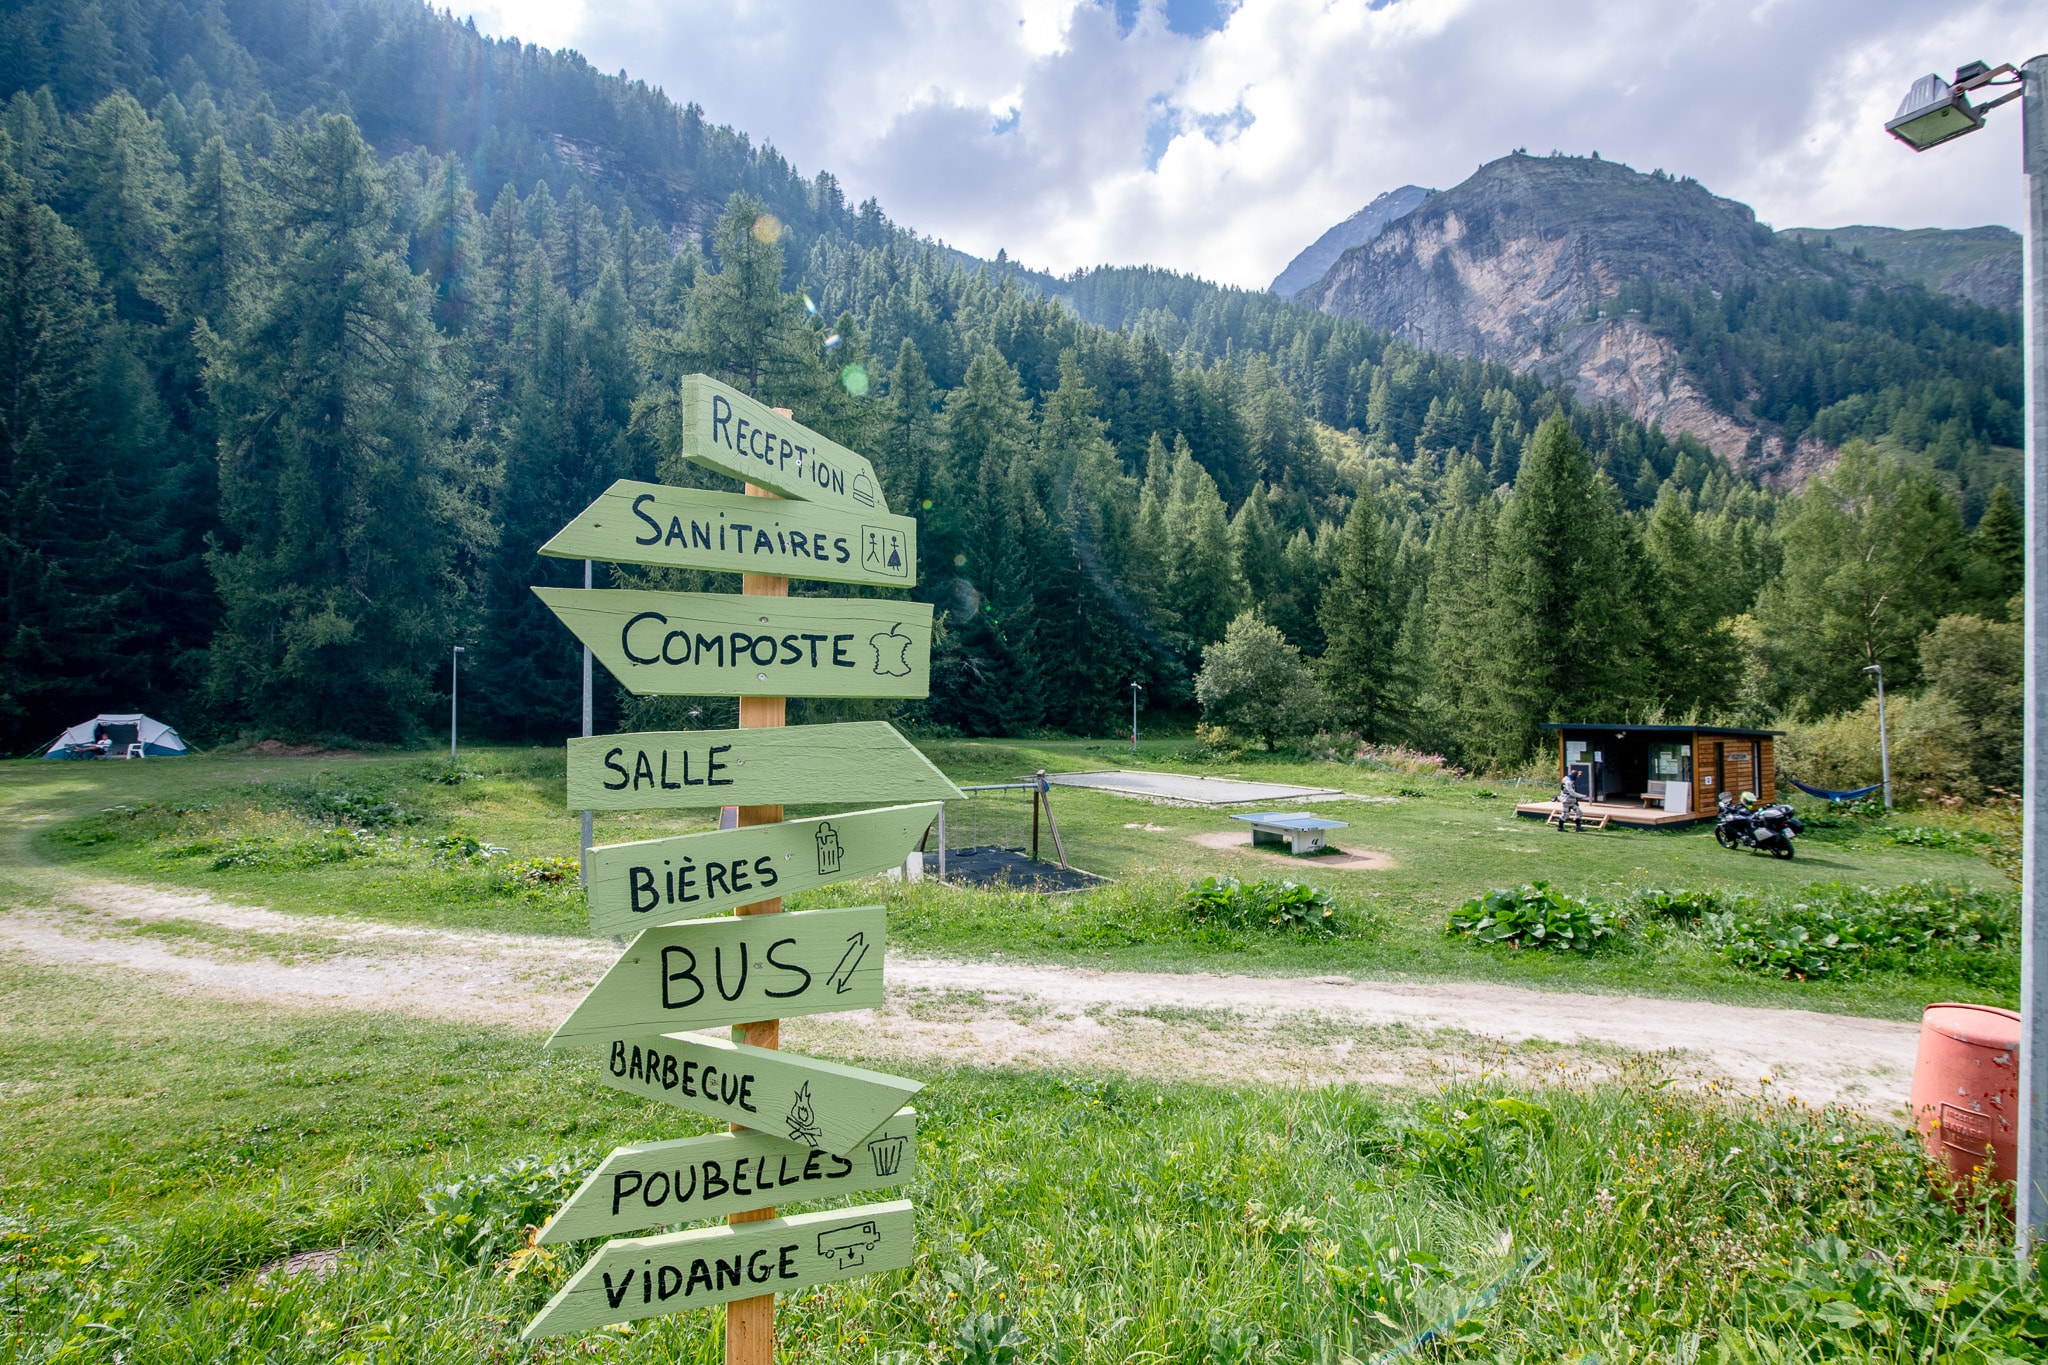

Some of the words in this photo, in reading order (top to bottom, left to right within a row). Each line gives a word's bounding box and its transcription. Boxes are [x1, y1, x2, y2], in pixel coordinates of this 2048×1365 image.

[621, 611, 856, 668] COMPOSTE
[603, 744, 734, 791] SALLE
[660, 938, 812, 1010] BUS
[609, 1039, 757, 1114] BARBECUE
[611, 1150, 853, 1216] POUBELLES
